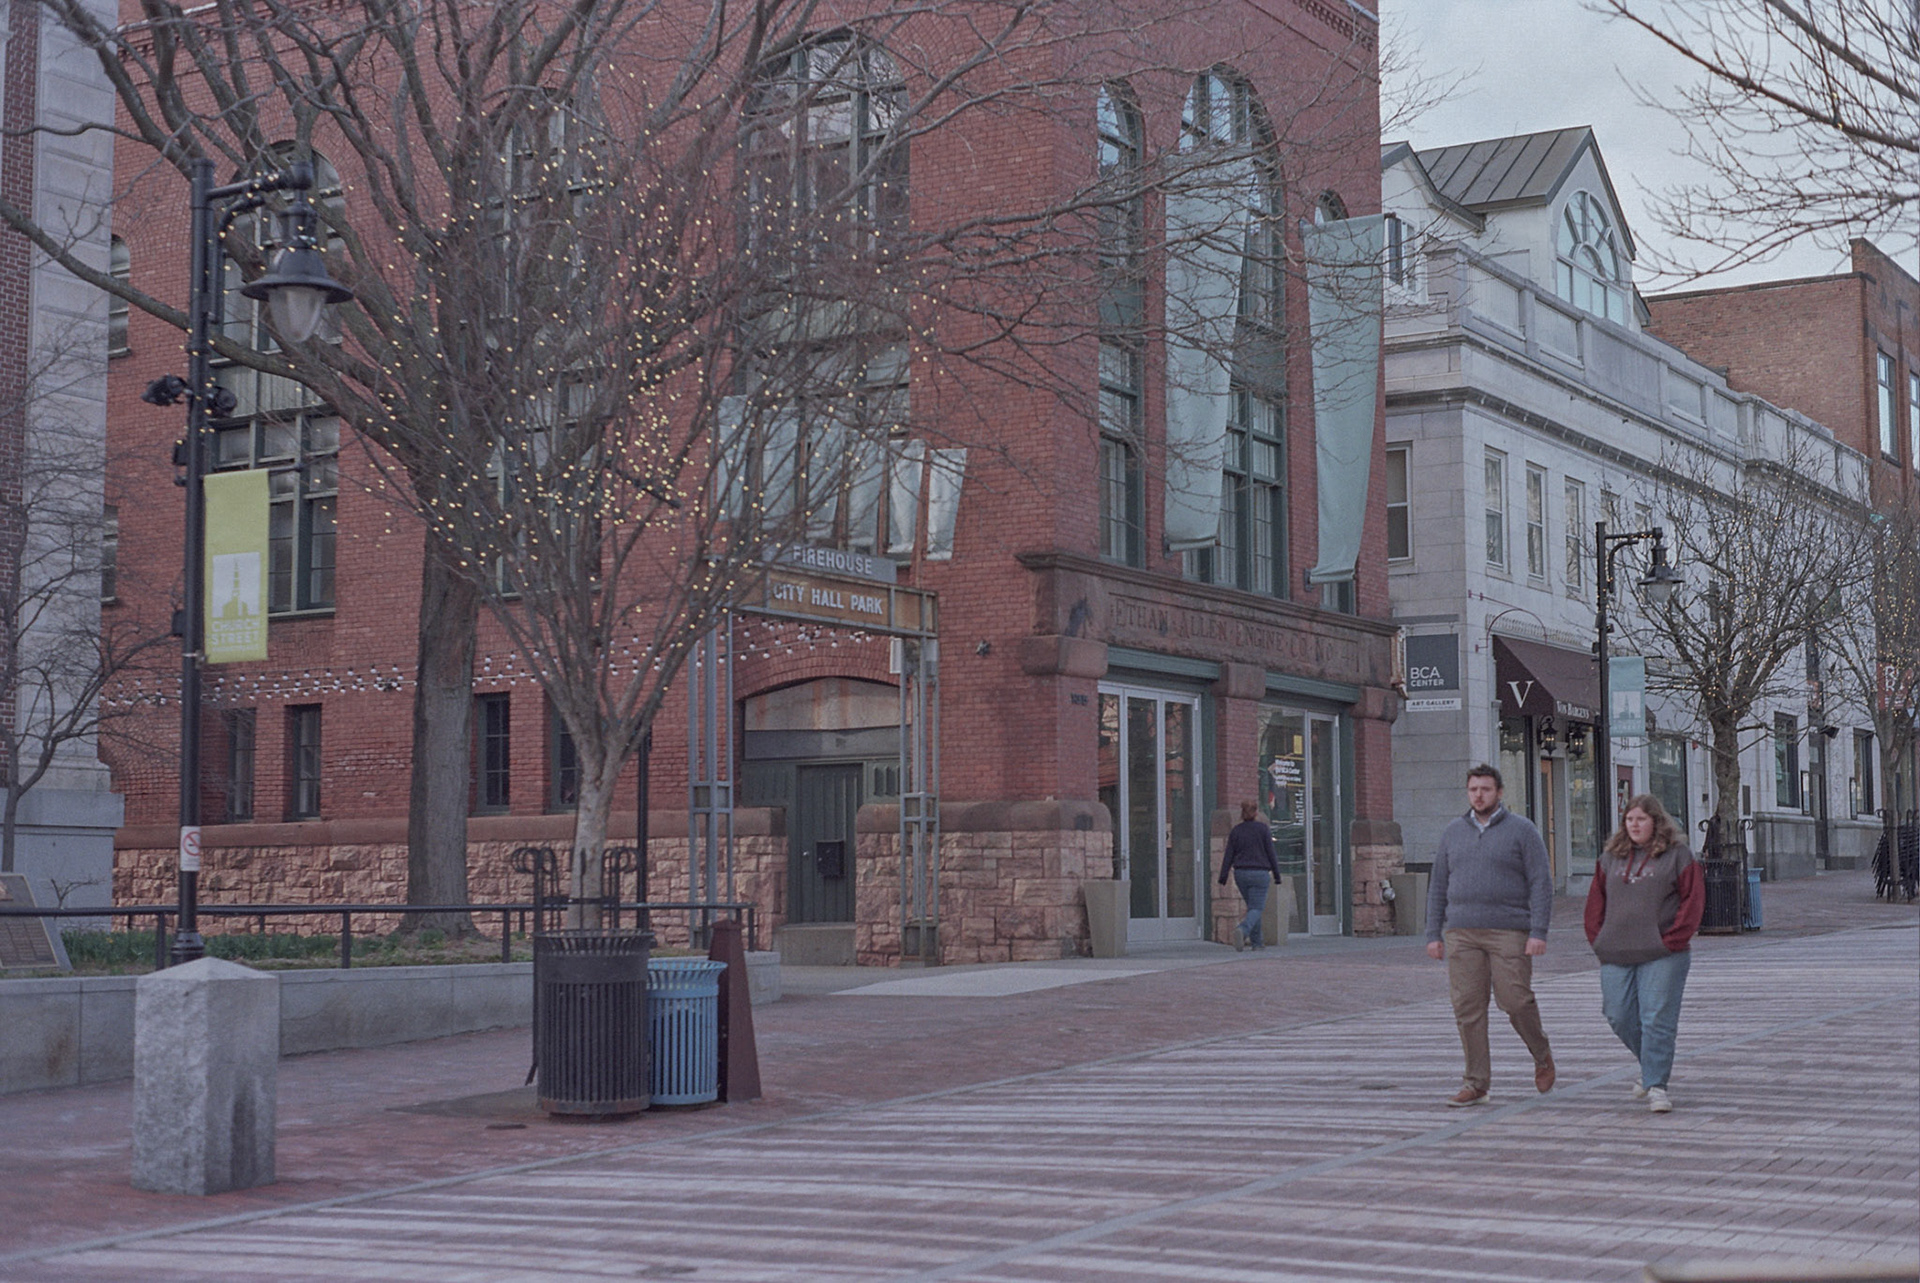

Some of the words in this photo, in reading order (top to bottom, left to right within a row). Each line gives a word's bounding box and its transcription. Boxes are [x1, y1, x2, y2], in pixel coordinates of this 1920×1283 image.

[792, 545, 873, 575] FIREHOUSE
[773, 583, 804, 603] CITY
[811, 588, 845, 609] HALL
[850, 594, 884, 615] PARK
[212, 618, 260, 632] CHURCH
[1115, 598, 1169, 632] ETHAN
[1178, 611, 1228, 641] ALLEN
[1235, 620, 1284, 652] ENGINE
[211, 630, 259, 645] STREET
[1410, 666, 1440, 679] BCA
[1410, 679, 1445, 687] CENTER
[1506, 680, 1535, 709] V
